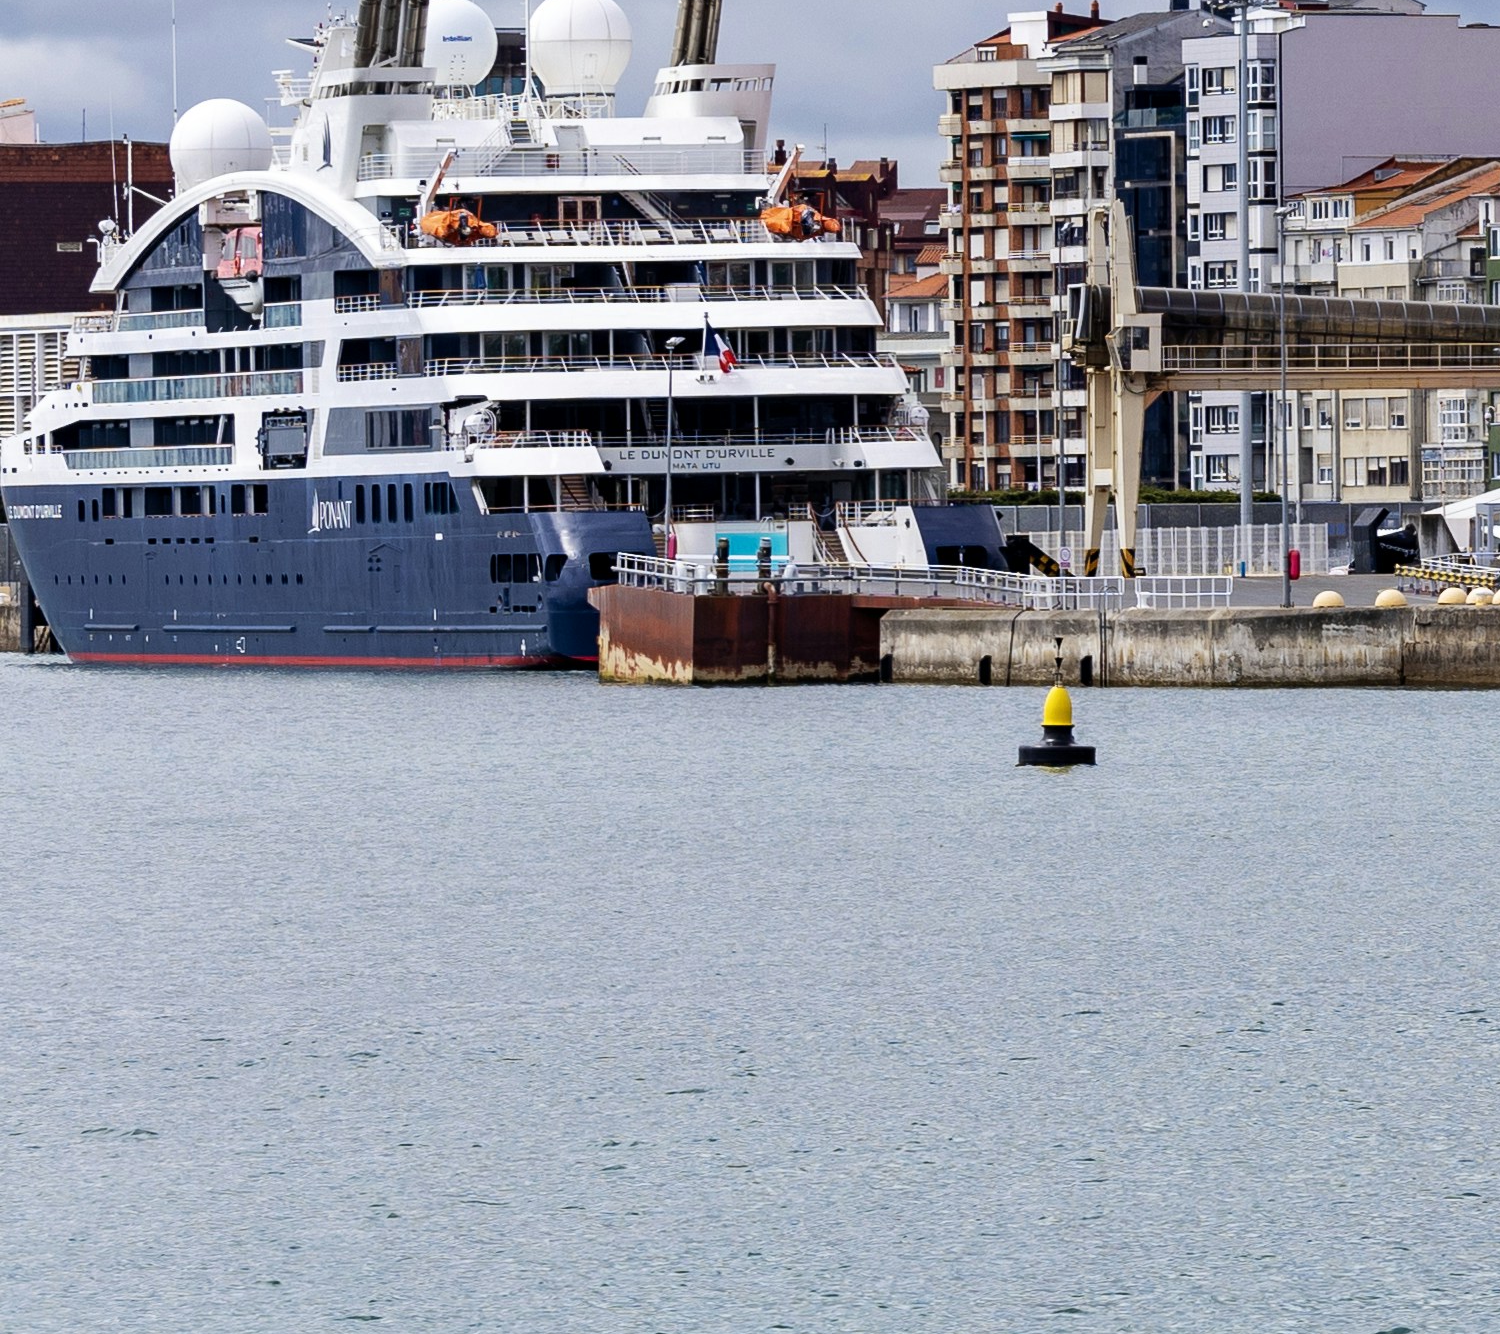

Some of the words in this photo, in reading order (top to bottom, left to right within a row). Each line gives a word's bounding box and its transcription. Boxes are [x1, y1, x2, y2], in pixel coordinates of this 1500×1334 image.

[619, 450, 635, 460] LE
[641, 449, 701, 460] DUMONT
[705, 448, 776, 459] D'URVILLE
[672, 462, 699, 470] MATA
[702, 462, 721, 470] UTU
[319, 500, 353, 529] PONANT
